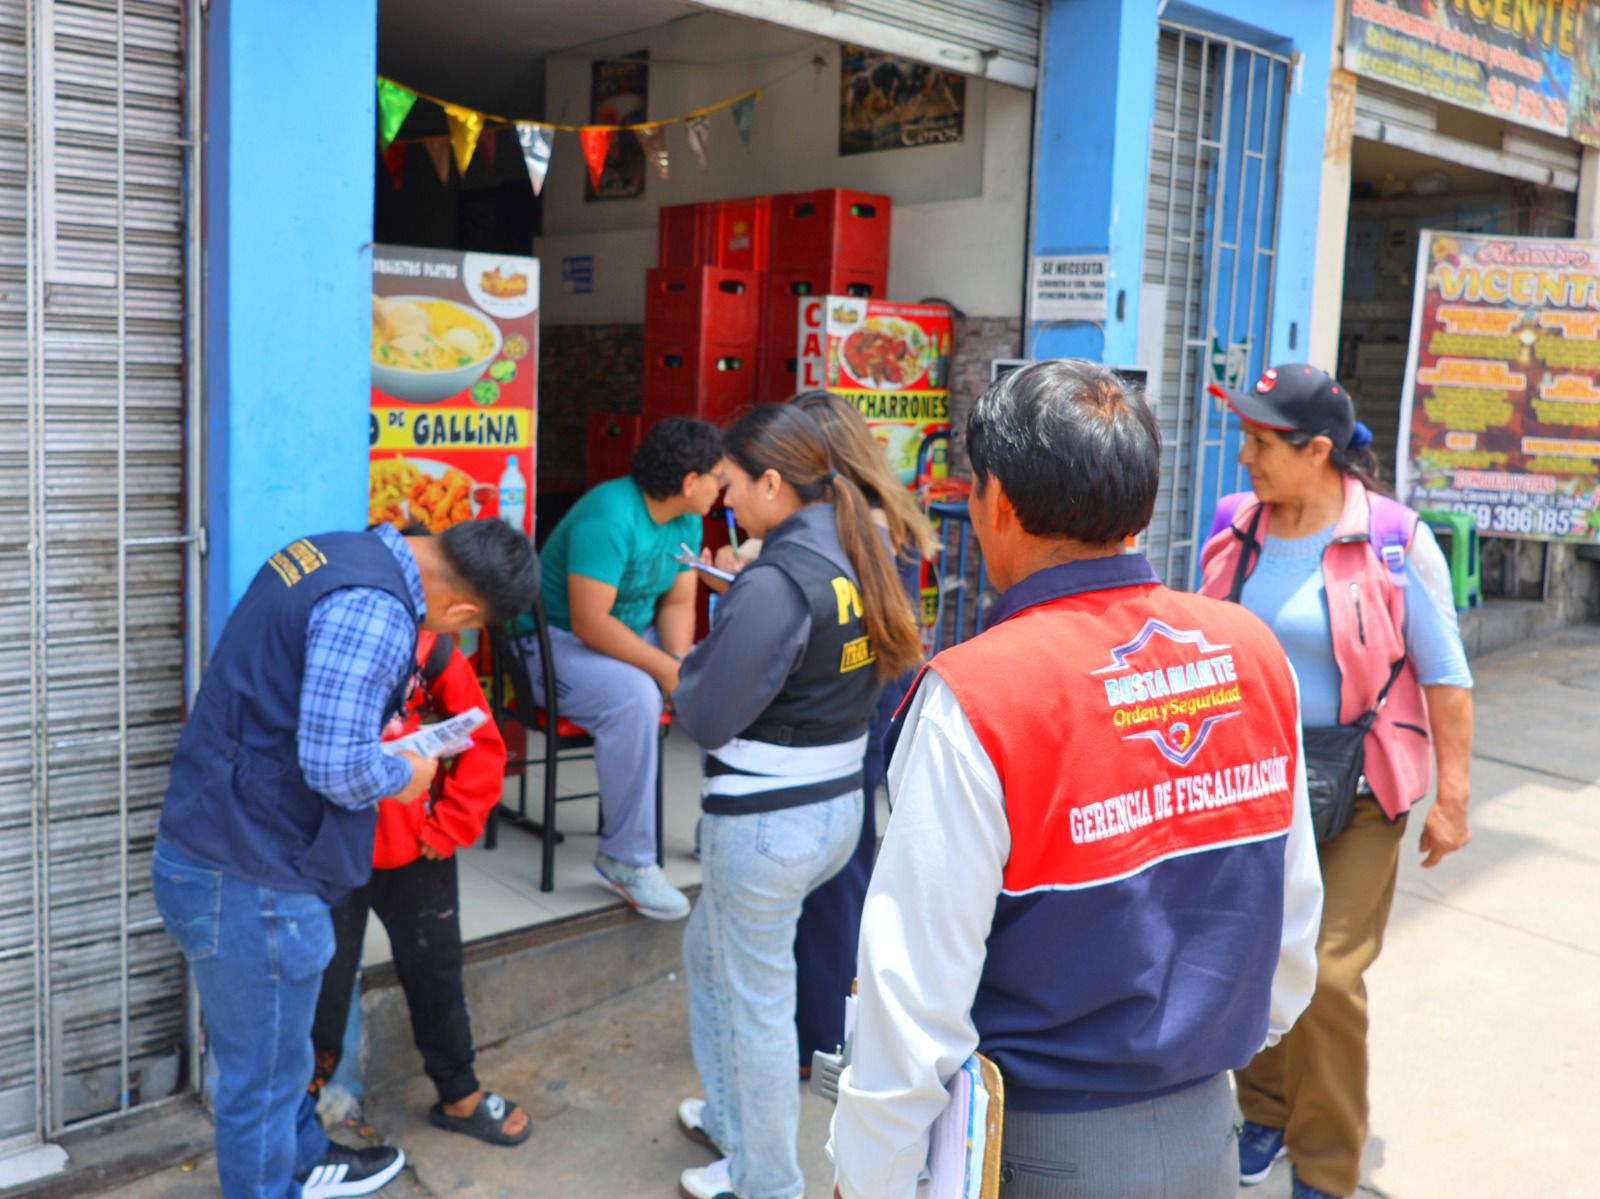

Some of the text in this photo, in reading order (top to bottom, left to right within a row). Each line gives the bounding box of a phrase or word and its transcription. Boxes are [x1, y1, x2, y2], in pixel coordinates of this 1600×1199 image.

[1437, 265, 1600, 306] VICENT
[388, 411, 405, 427] DE
[1493, 505, 1532, 533] 396
[1537, 508, 1570, 536] 185
[1103, 654, 1238, 707] BUSTAMANTE
[1113, 704, 1159, 727] Orden
[1168, 682, 1242, 715] Seguridad
[1069, 745, 1289, 844] GERENCIA DE FISCALIZACIÓN
